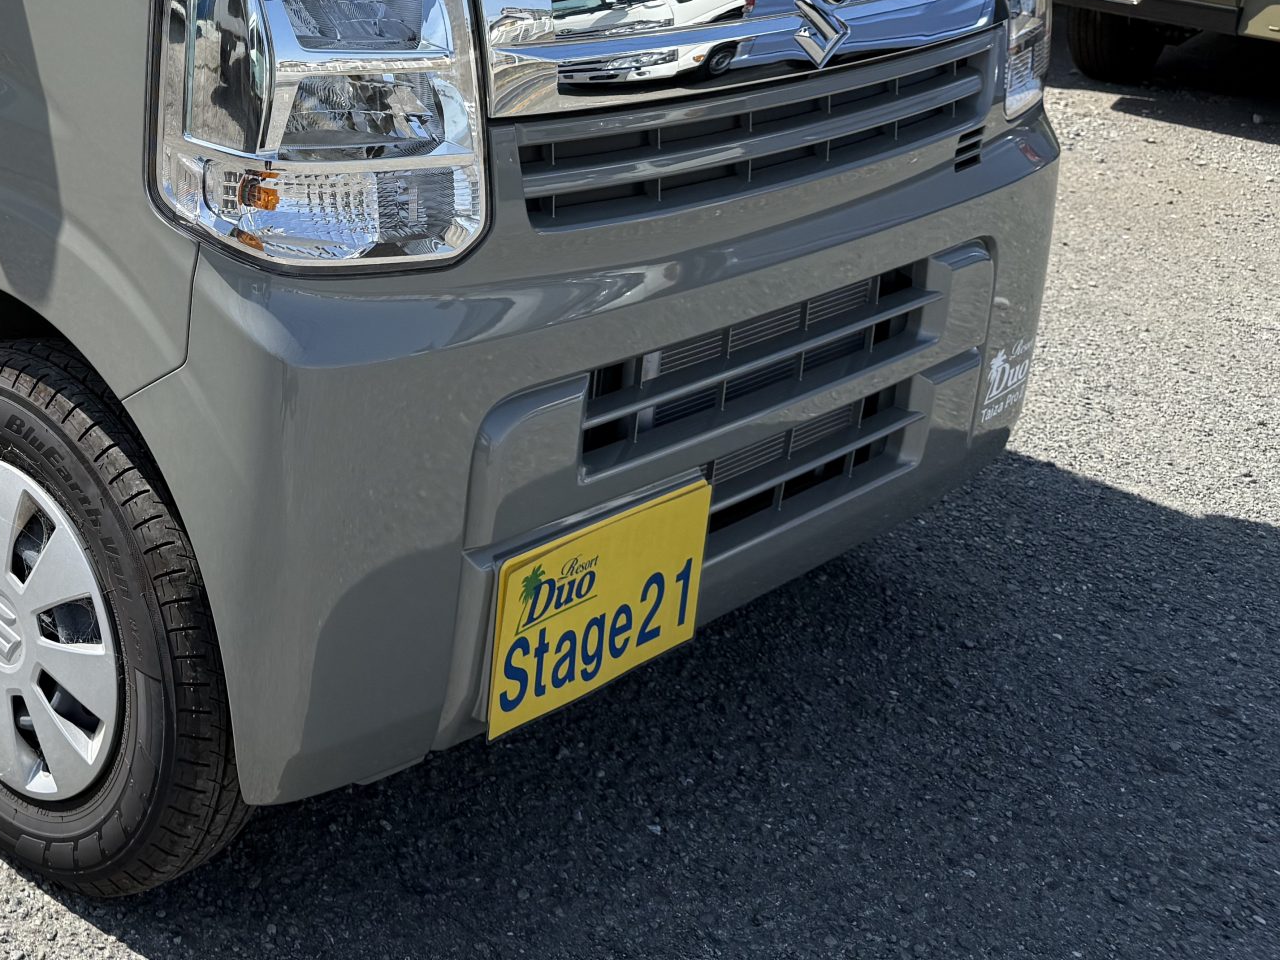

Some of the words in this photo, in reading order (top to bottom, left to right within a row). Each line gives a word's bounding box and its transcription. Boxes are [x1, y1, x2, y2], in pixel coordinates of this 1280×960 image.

[988, 359, 1029, 398] Duo
[980, 402, 1004, 423] Taiza
[557, 553, 600, 582] Resort
[523, 570, 597, 628] Duo
[499, 557, 694, 713] Stage21
